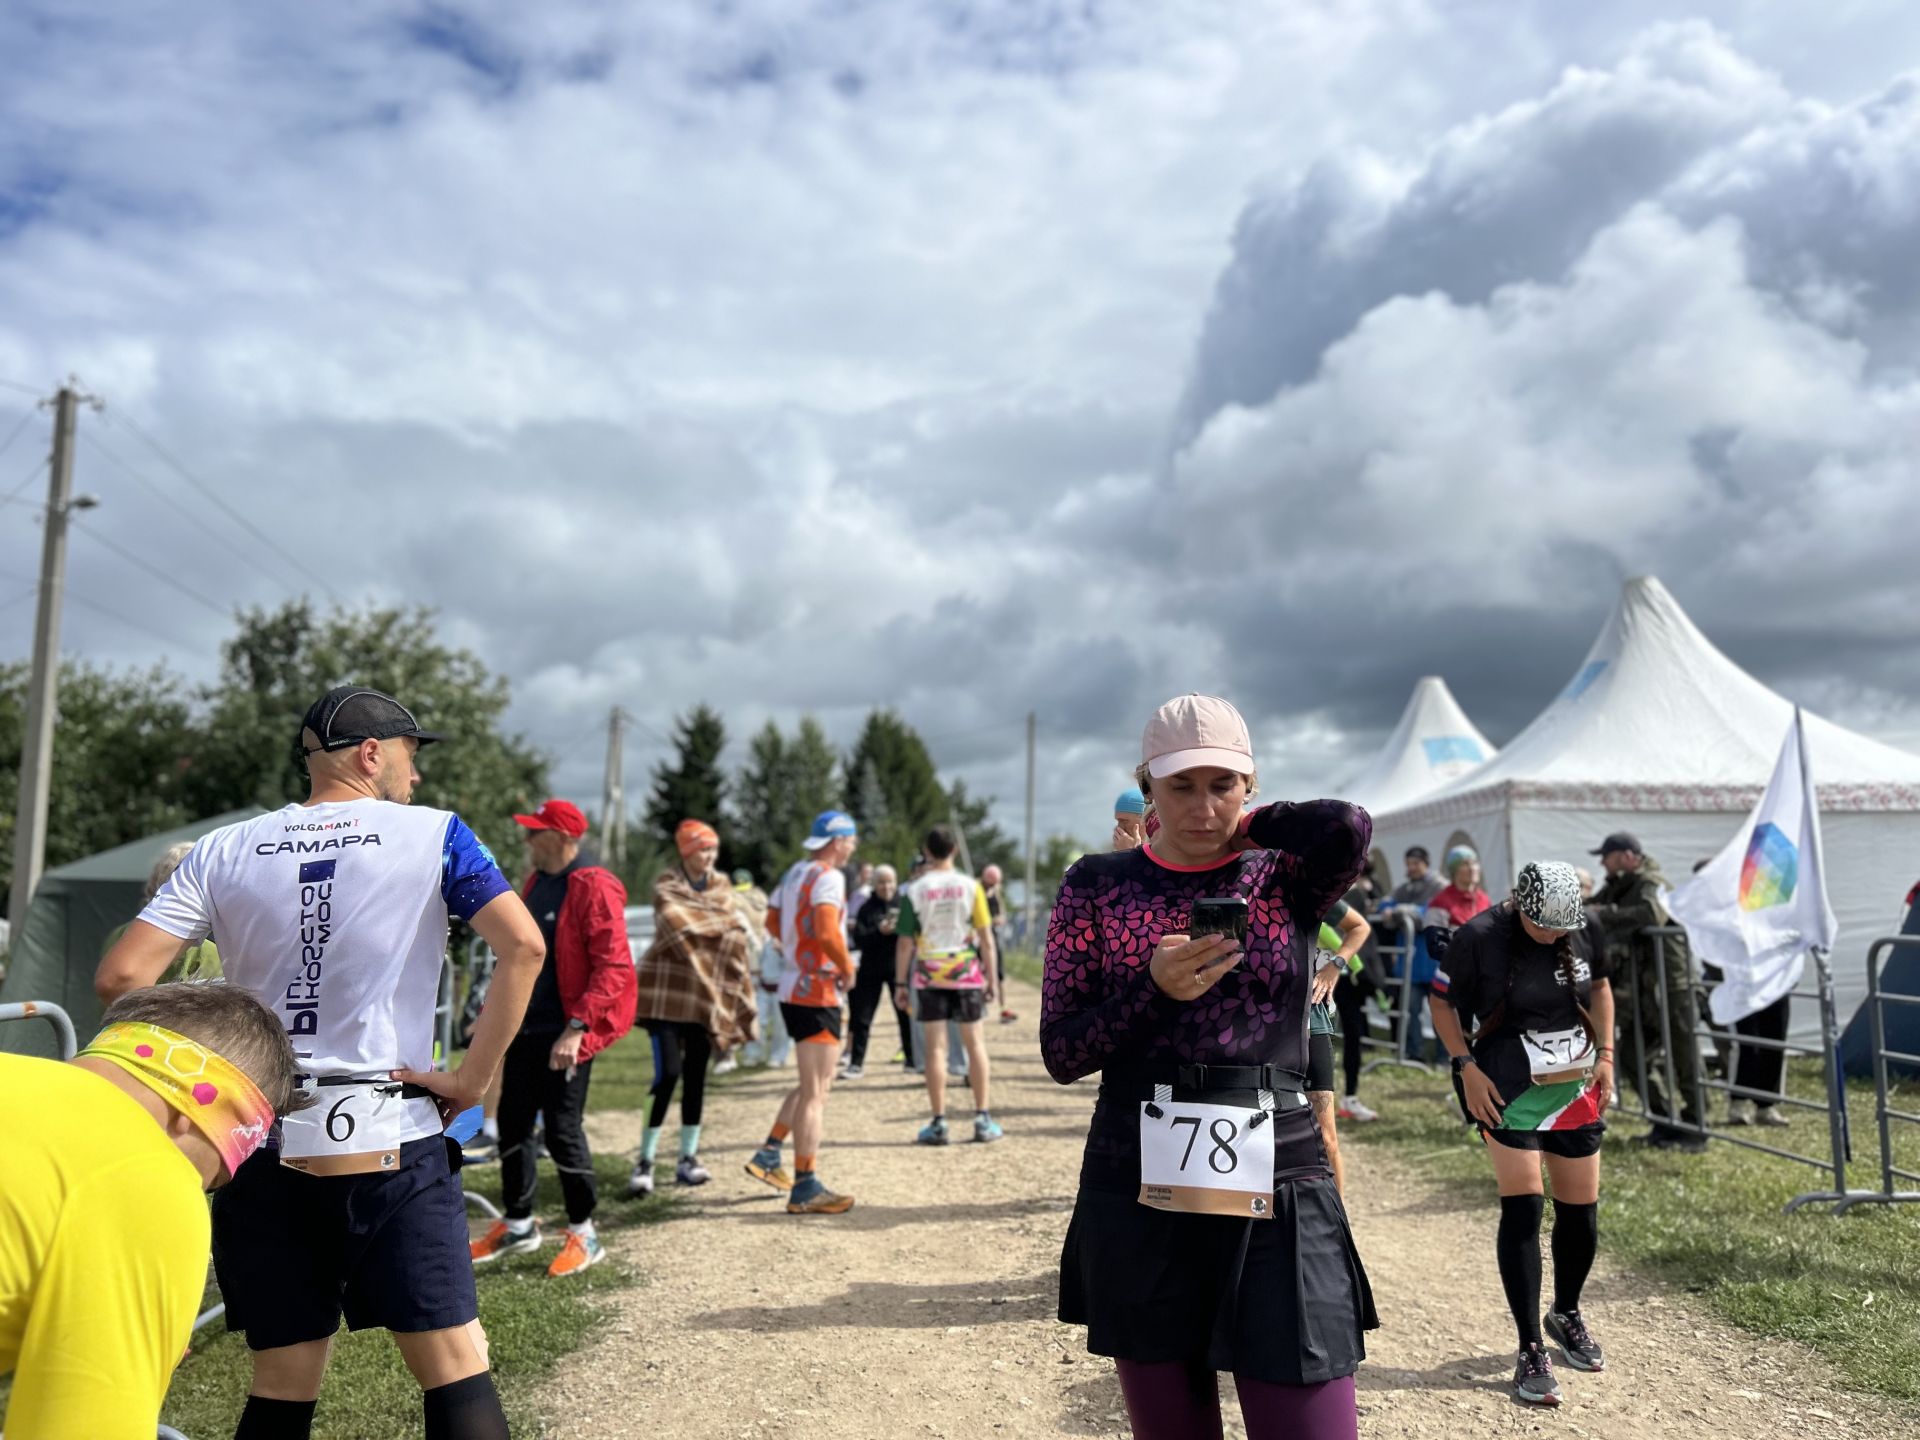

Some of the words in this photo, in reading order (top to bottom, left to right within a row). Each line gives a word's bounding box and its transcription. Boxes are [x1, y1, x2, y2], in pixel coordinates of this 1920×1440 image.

[284, 820, 352, 833] VOLGAMAN
[255, 833, 382, 856] САМАРА
[1541, 1037, 1573, 1066] 57
[325, 1094, 357, 1143] 6
[1169, 1115, 1238, 1174] 78
